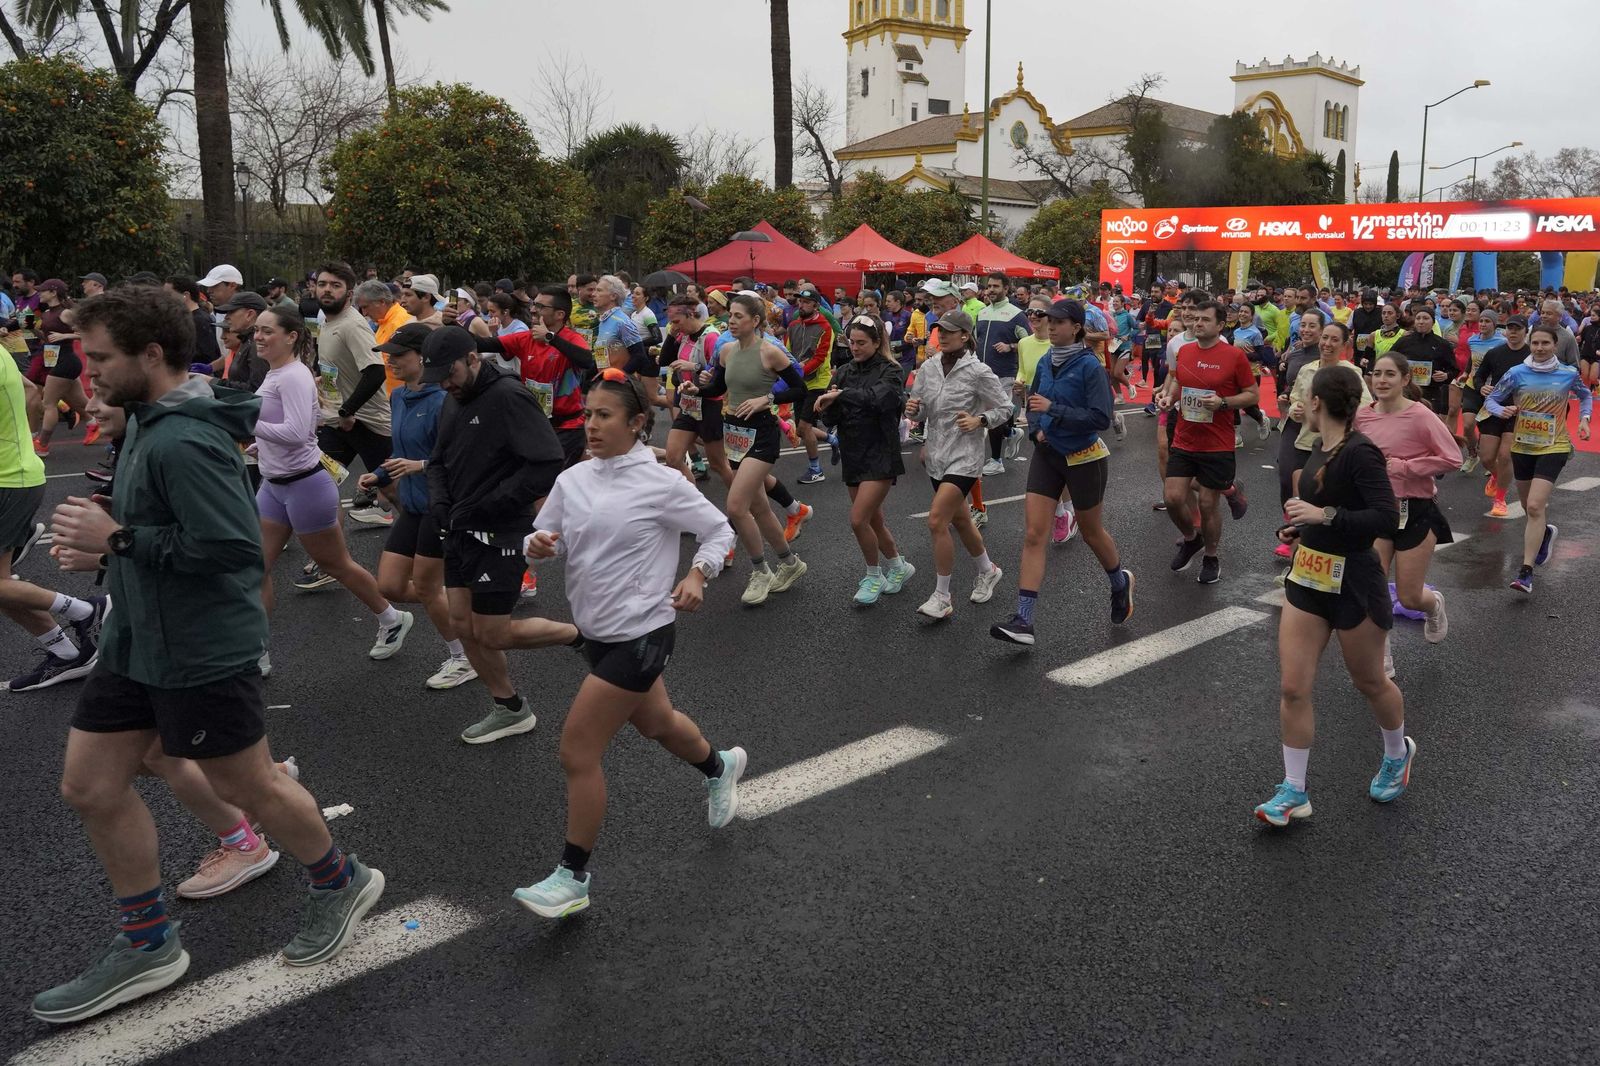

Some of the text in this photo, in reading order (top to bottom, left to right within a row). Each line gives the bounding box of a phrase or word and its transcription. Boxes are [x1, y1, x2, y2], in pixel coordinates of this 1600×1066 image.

[1369, 212, 1443, 226] maratón
[1536, 215, 1596, 232] HOKA
[1181, 224, 1219, 234] Sprinter
[1258, 221, 1302, 236] HOKA
[1386, 222, 1443, 239] sevilla
[1459, 220, 1521, 233] 00:11:23
[1411, 367, 1428, 376] 432
[1183, 396, 1203, 408] 1918
[1520, 418, 1549, 432] 15443
[725, 432, 749, 449] 20798
[1295, 549, 1333, 576] 13451
